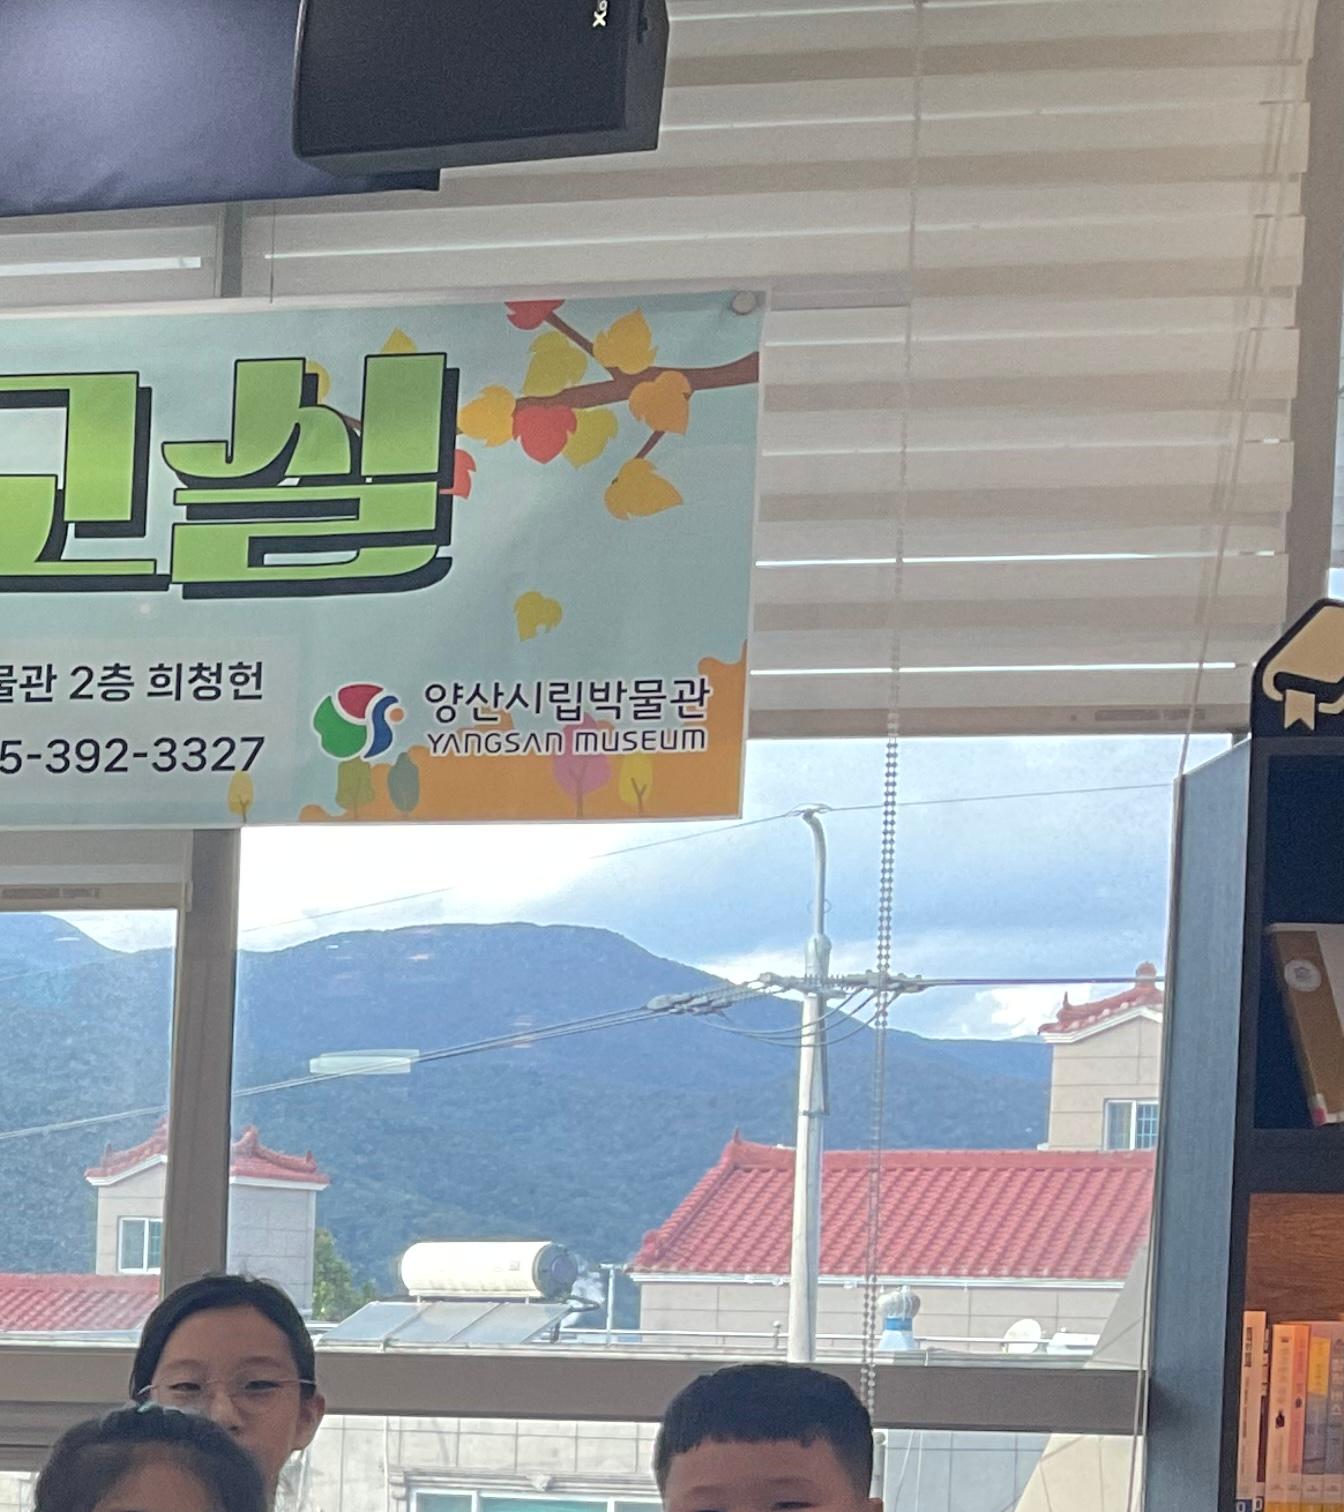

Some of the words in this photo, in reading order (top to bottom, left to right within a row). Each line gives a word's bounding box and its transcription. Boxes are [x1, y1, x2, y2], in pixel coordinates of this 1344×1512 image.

[69, 662, 135, 702] 2층
[147, 661, 263, 702] 희청헌
[425, 678, 711, 724] 양산시립박물관
[427, 732, 563, 754] YANGSAN
[575, 728, 705, 752] MUSEUM
